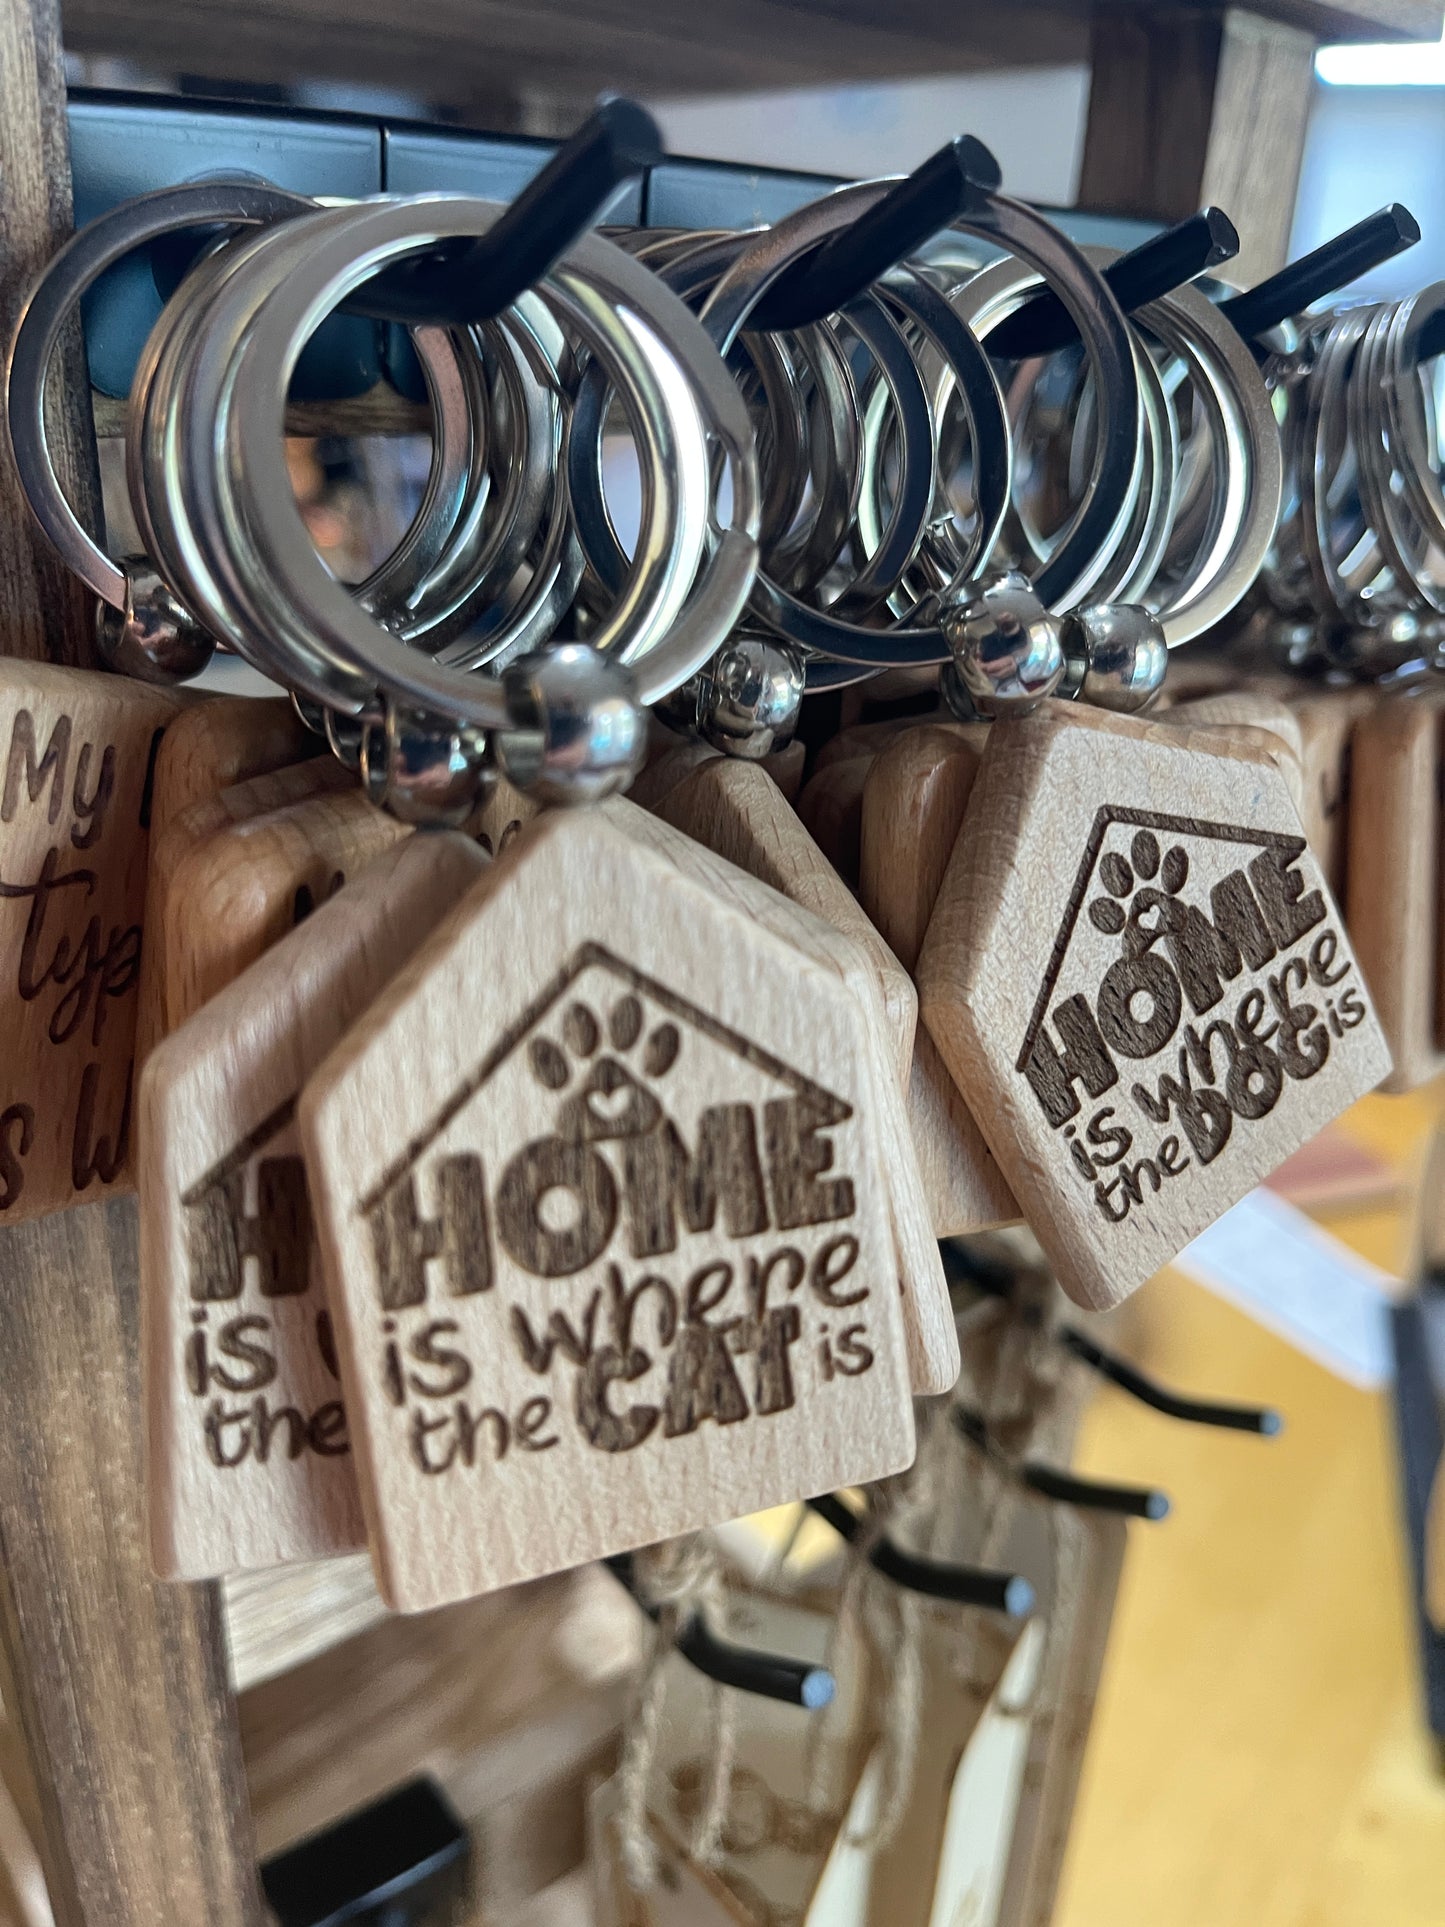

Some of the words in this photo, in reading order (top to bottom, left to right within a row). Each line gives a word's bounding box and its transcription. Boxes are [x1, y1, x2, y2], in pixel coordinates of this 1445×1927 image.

[1, 708, 115, 849] My
[0, 847, 142, 1046] typ
[1025, 838, 1327, 1129] HOME
[1063, 1106, 1133, 1182] is
[1131, 928, 1351, 1122] where
[1095, 1134, 1190, 1222] the
[1176, 1002, 1330, 1166] DOG
[1323, 988, 1366, 1038] is
[366, 1097, 857, 1311] HOME
[185, 1306, 276, 1397] is
[380, 1319, 472, 1406] is
[510, 1233, 870, 1375] where
[408, 1396, 560, 1475] the
[574, 1304, 801, 1453] CAT
[815, 1322, 874, 1381] is
[205, 1394, 350, 1467] the
